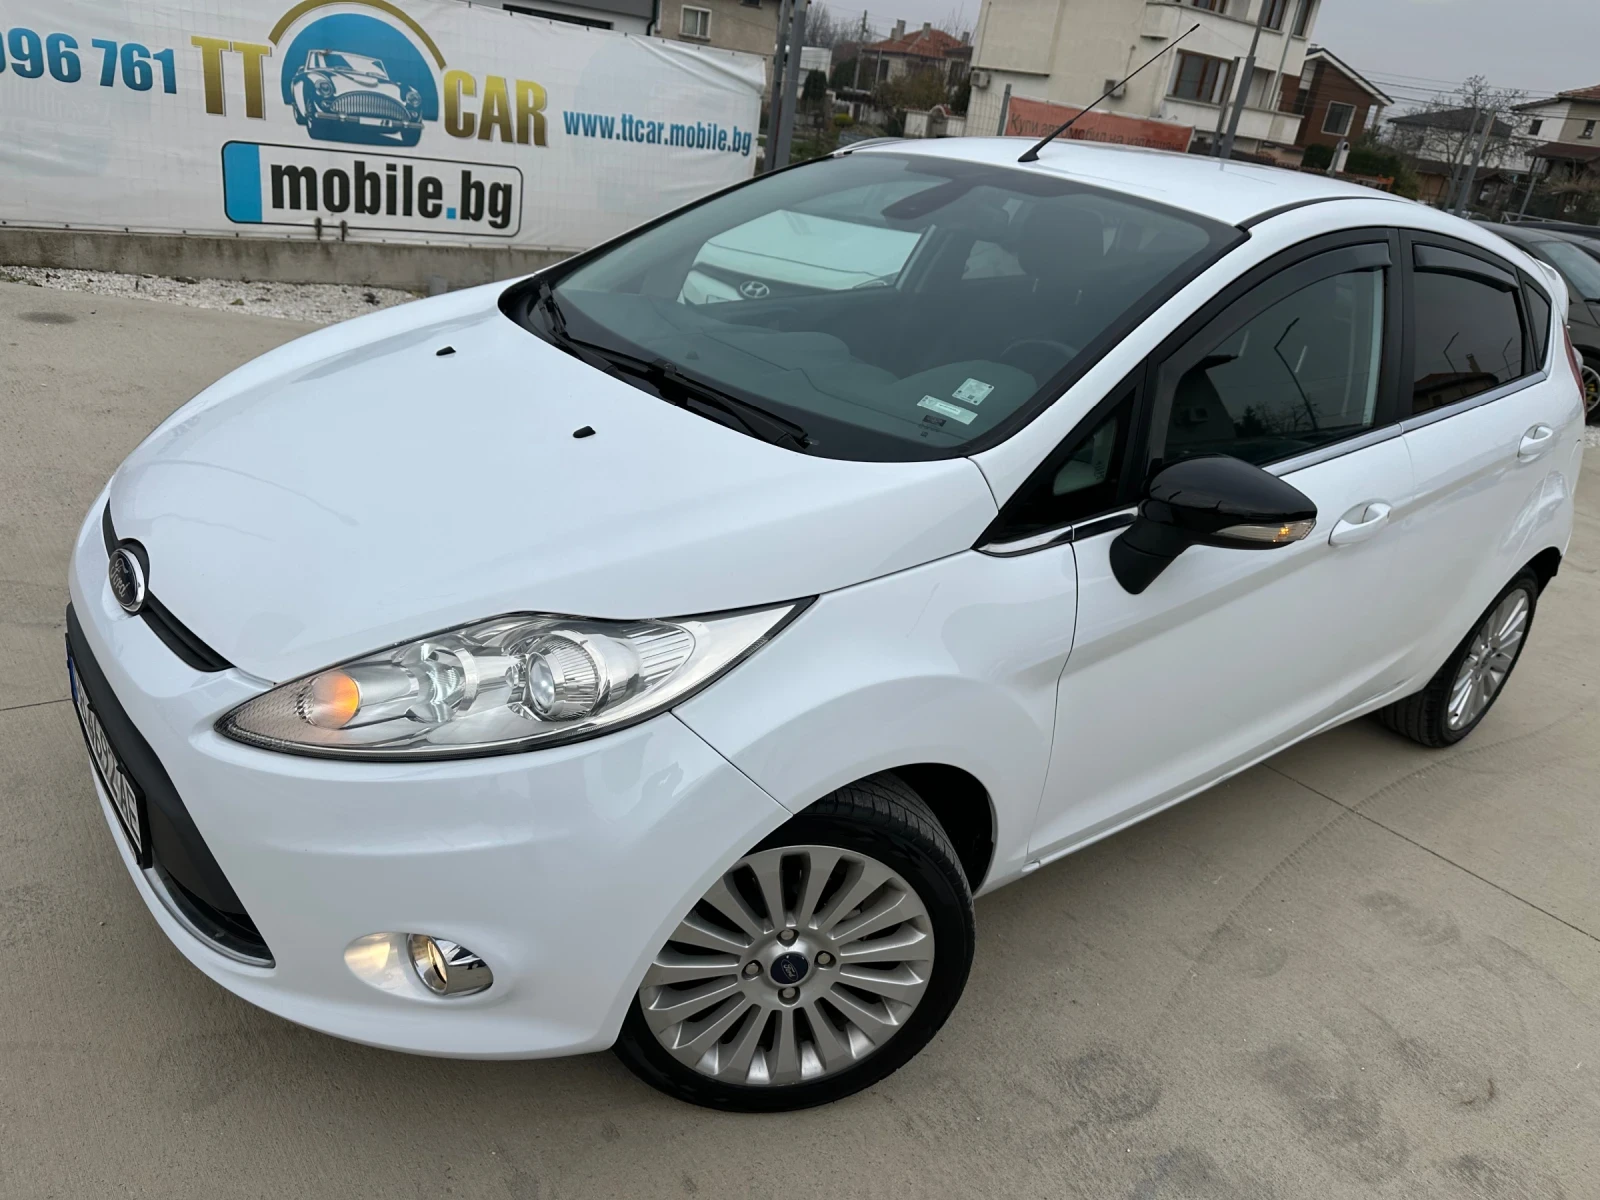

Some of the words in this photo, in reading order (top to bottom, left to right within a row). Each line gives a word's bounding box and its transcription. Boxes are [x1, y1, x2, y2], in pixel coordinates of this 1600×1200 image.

[0, 28, 82, 84] 96
[91, 38, 178, 95] 761
[190, 35, 273, 121] TT
[443, 69, 549, 147] CAR
[563, 110, 752, 157] www.ttcar.mobile.bg
[1042, 122, 1107, 143] авомобил
[270, 160, 513, 230] mobile.bg
[110, 557, 131, 598] Ford
